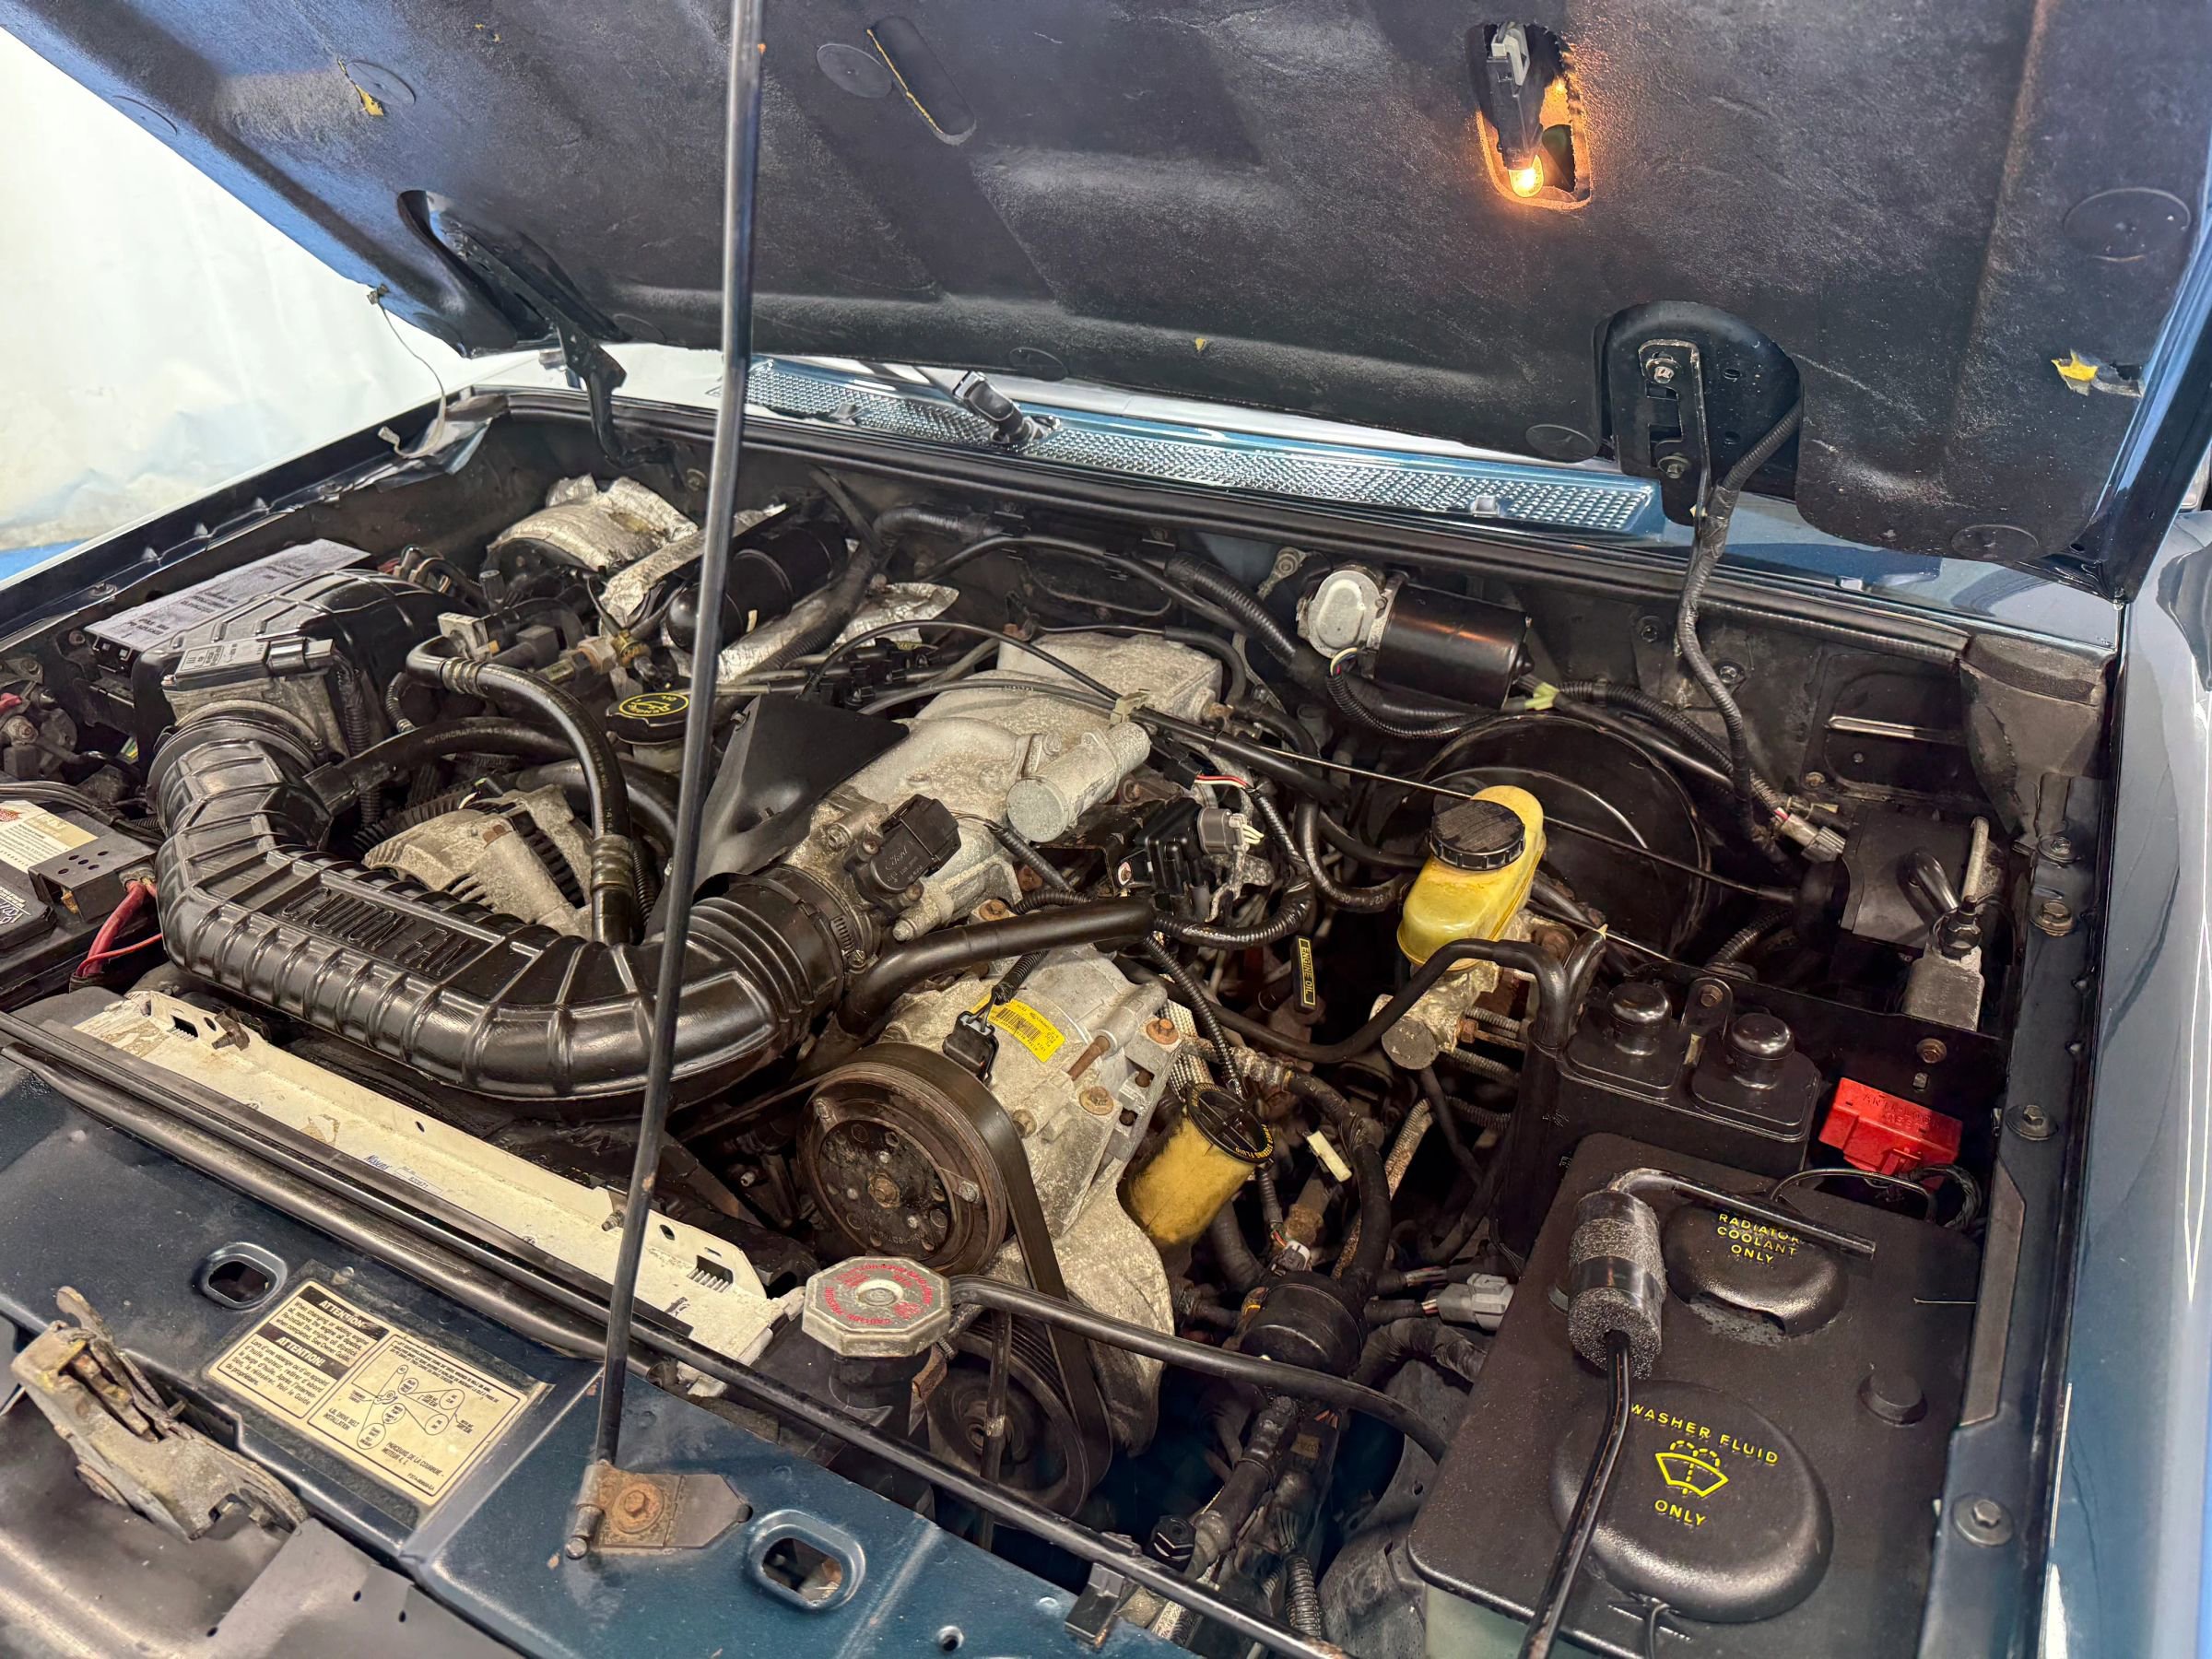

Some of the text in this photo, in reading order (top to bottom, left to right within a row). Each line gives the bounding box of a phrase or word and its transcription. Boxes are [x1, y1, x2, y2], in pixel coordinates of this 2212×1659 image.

[282, 887, 479, 976] CAUTION FAN
[1302, 947, 1312, 978] ENGINE
[1717, 1227, 1797, 1255] COOLANT
[1719, 1214, 1799, 1244] RADIATOR
[1731, 1245, 1773, 1264] ONLY
[293, 1301, 308, 1311] When
[349, 1334, 369, 1347] engine
[295, 1312, 312, 1322] remove
[319, 1325, 335, 1336] engine
[275, 1335, 325, 1367] ATTENTION!
[311, 1330, 329, 1342] engine
[335, 1343, 358, 1357] dipstick
[320, 1342, 337, 1353] Owner
[262, 1356, 285, 1371] moteur,
[284, 1368, 302, 1380] retirer
[301, 1377, 324, 1392] d'abord
[276, 1382, 288, 1392] Voir
[293, 1393, 312, 1405] Guide
[1631, 1404, 1779, 1465] WASHER FLUID
[1655, 1500, 1706, 1526] ONLY
